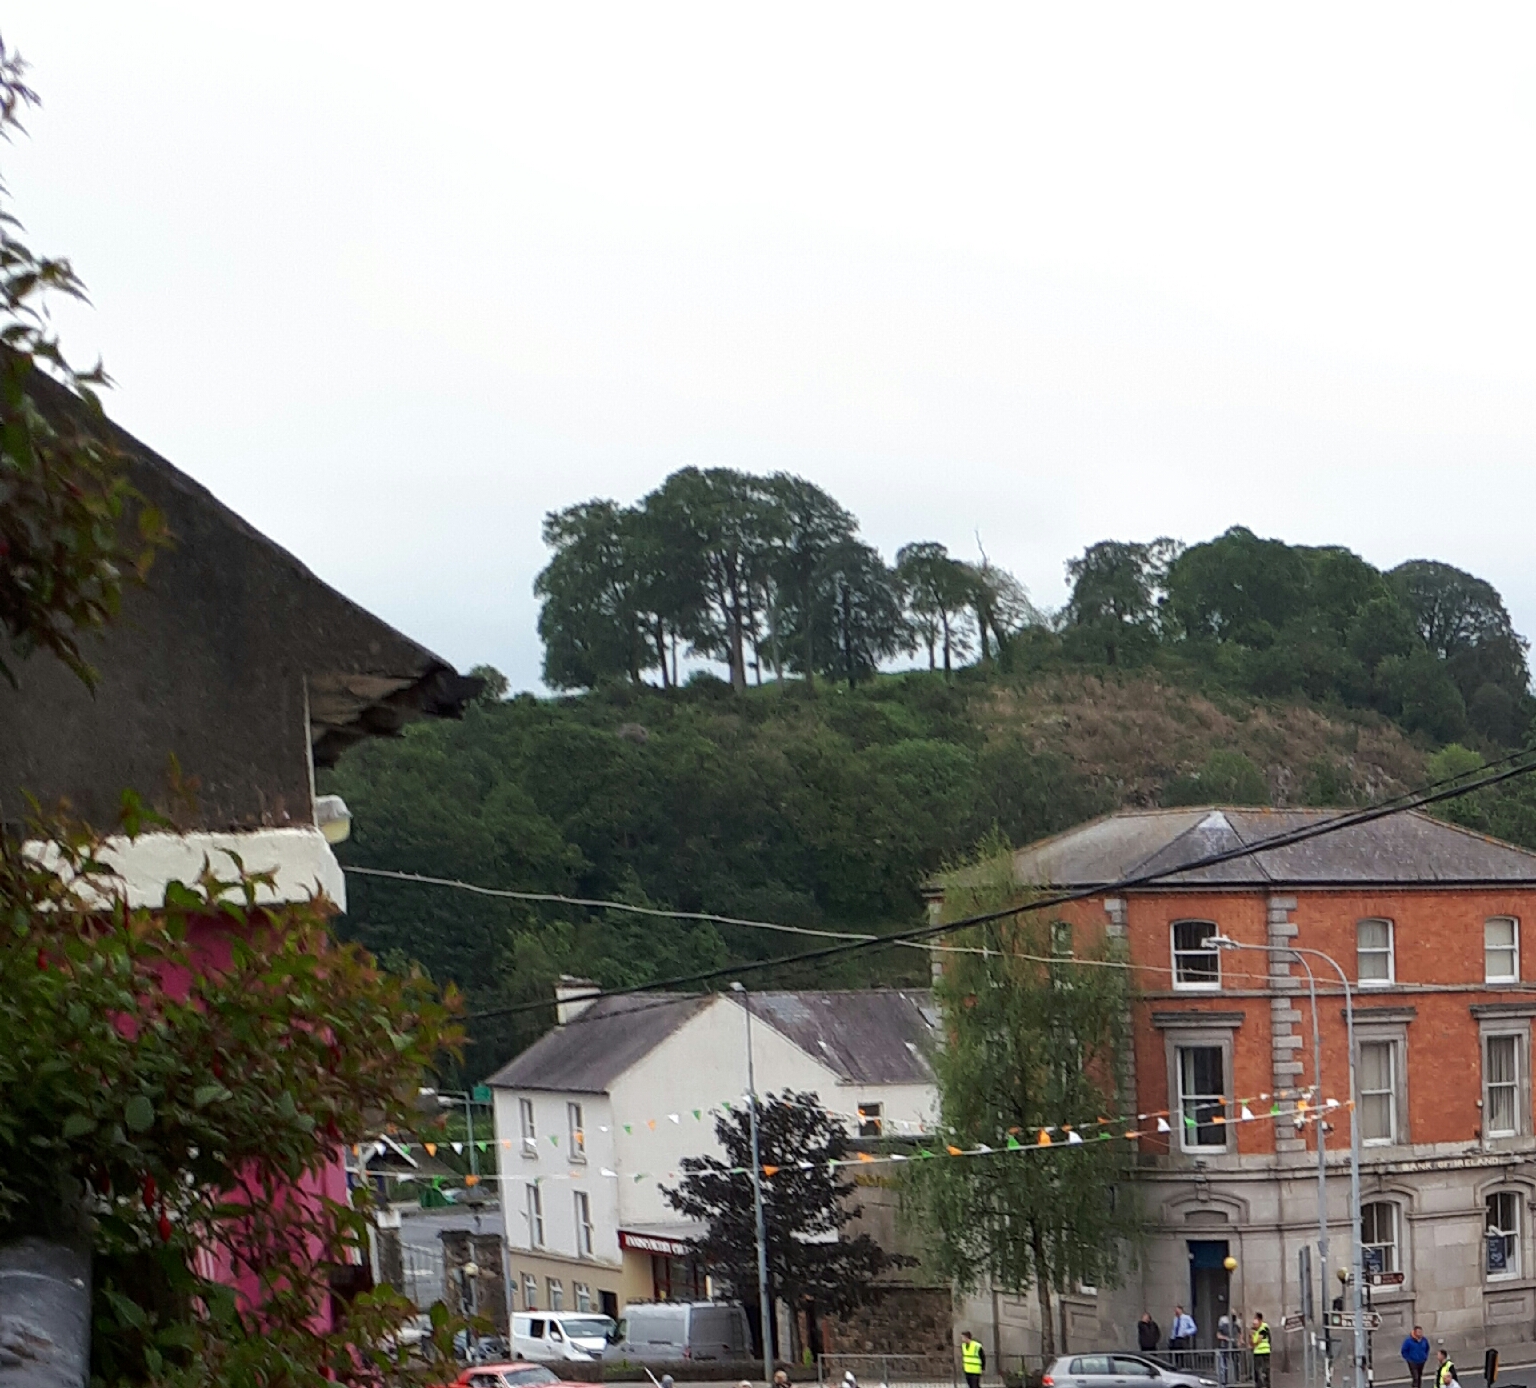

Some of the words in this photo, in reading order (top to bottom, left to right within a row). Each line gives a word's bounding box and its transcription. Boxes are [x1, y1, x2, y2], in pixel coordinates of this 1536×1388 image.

[1402, 1161, 1433, 1173] BANK
[1437, 1160, 1451, 1170] OF
[1454, 1157, 1499, 1168] IRELAND
